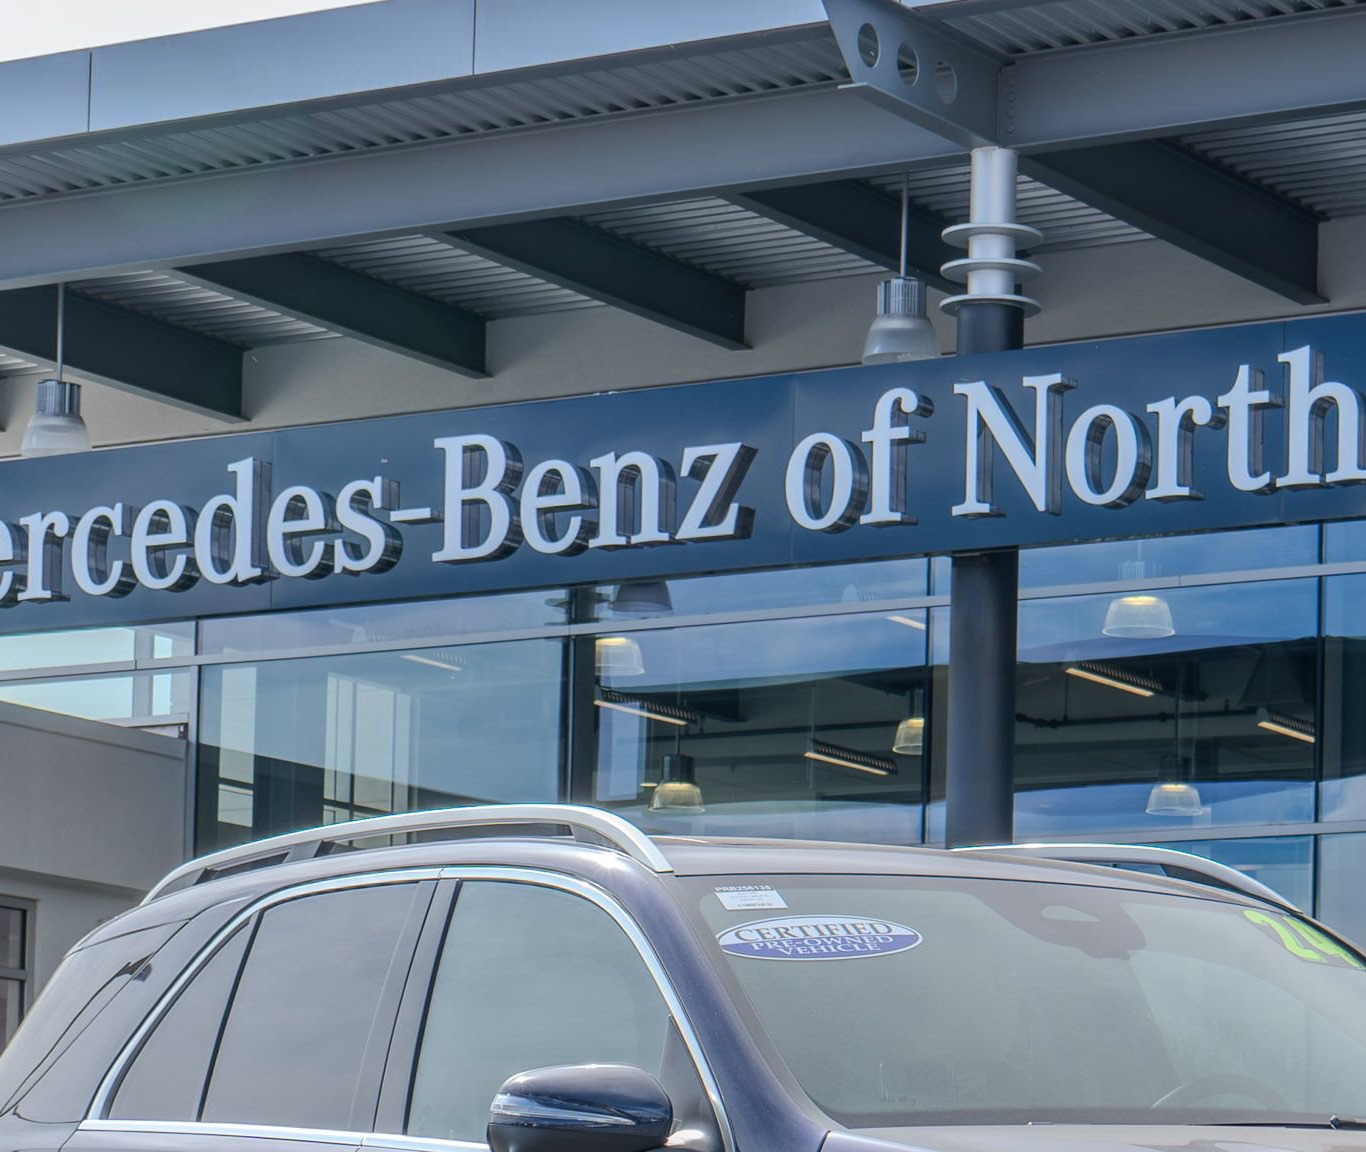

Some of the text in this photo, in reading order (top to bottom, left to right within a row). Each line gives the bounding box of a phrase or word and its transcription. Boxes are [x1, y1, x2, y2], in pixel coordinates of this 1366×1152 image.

[785, 387, 927, 533] of
[735, 922, 893, 942] CERTIFIED
[1243, 909, 1366, 970] 24
[749, 936, 894, 950] PRE-OWNED
[778, 943, 882, 956] VEHICLE
